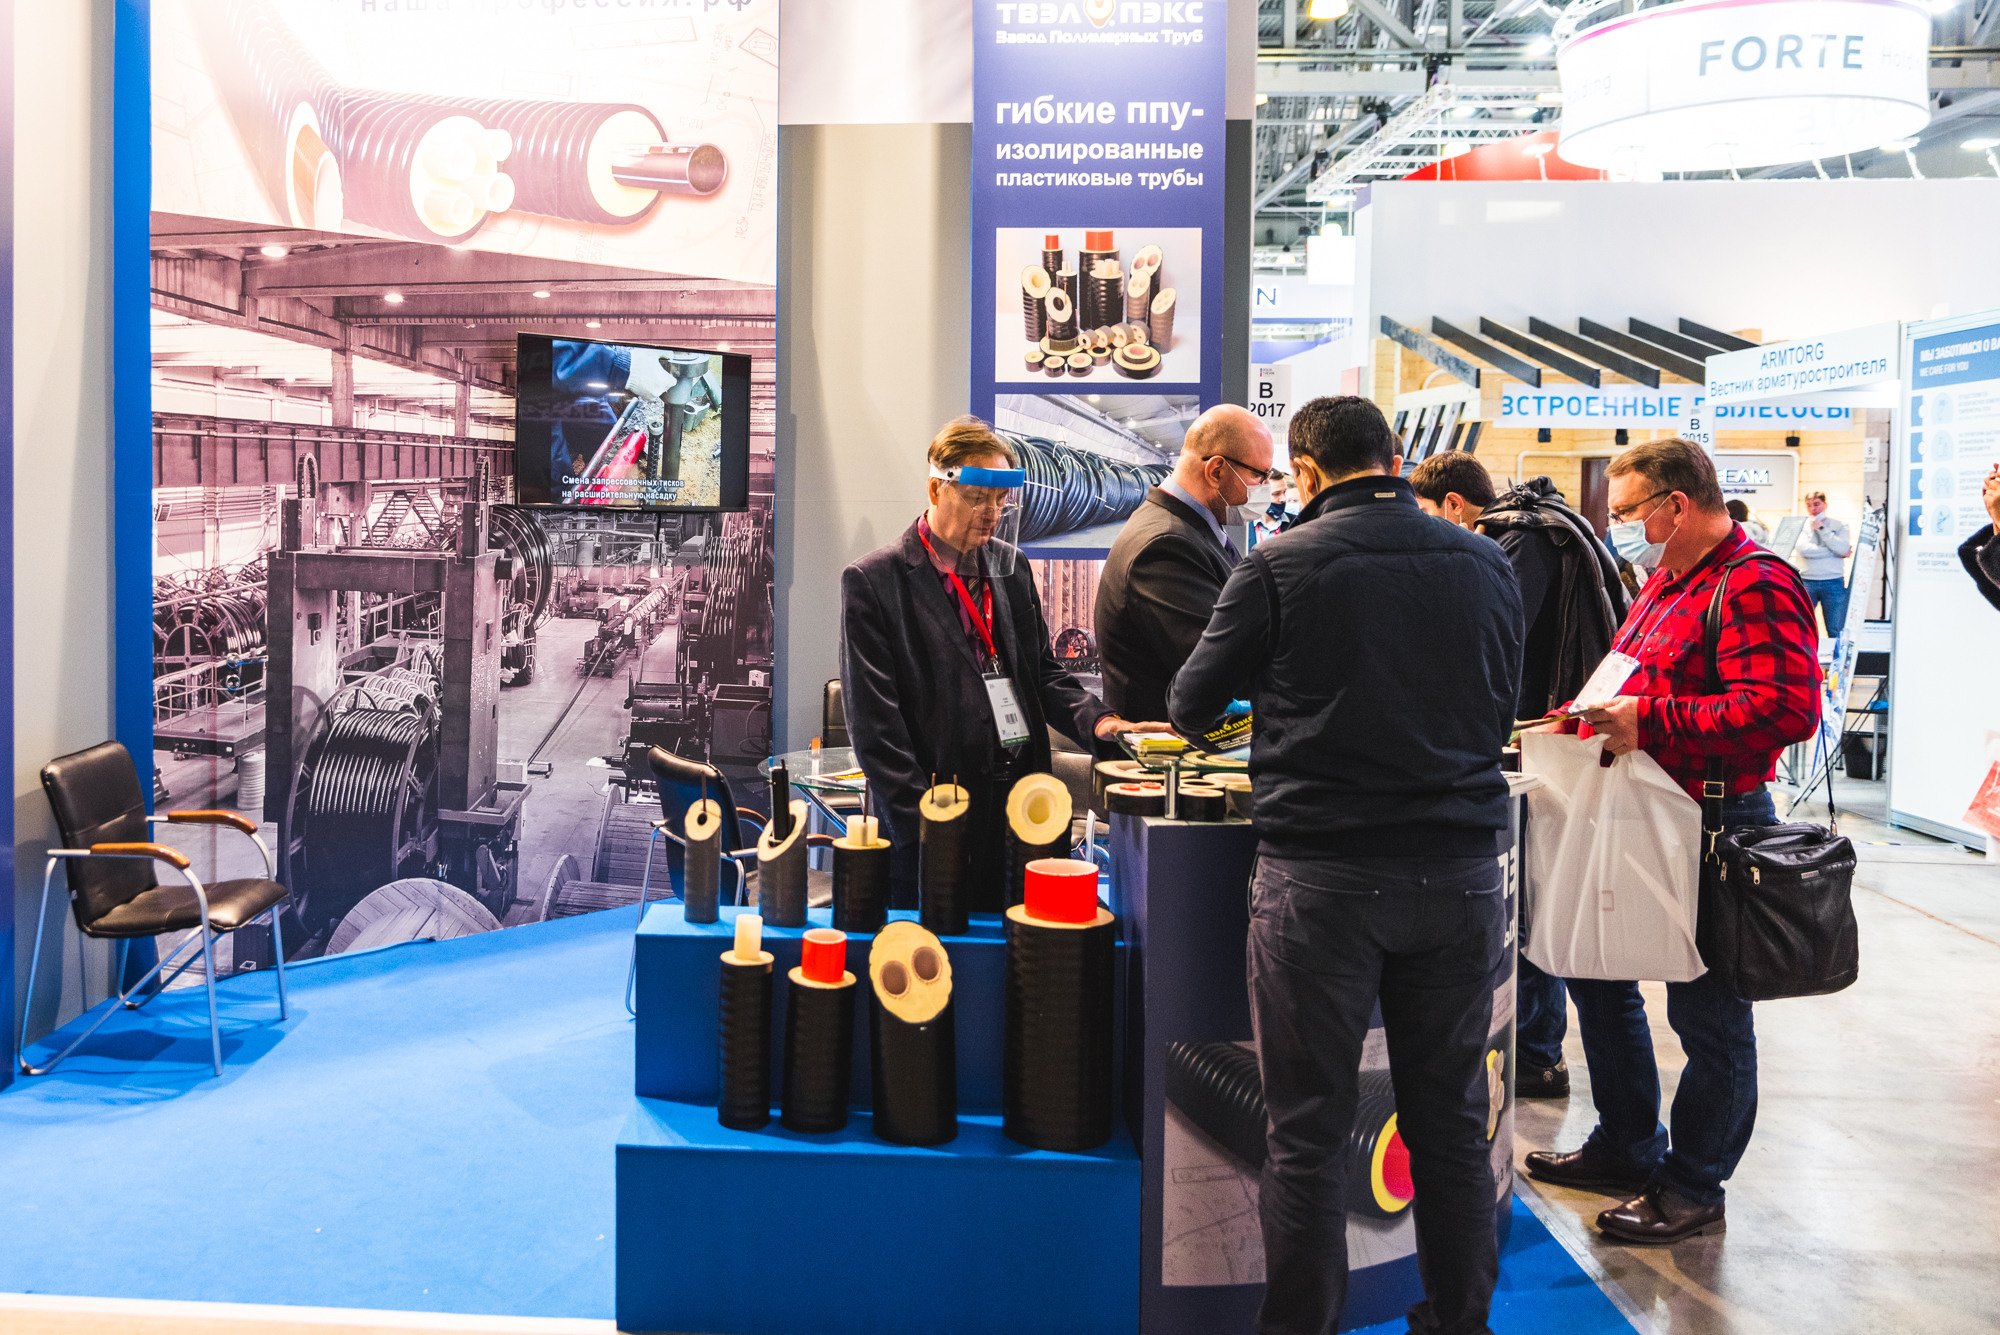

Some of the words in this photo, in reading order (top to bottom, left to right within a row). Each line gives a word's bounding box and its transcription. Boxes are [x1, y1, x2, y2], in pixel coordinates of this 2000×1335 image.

[996, 3, 1082, 25] ТВЭЛ
[1119, 2, 1204, 24] ПЭКС
[1161, 29, 1204, 46] Труб
[1698, 34, 1865, 77] FORTE
[996, 94, 1116, 124] гибкие
[1127, 101, 1205, 131] ппу-
[996, 142, 1204, 165] изолированные
[996, 172, 1133, 187] пластиковые
[1137, 168, 1204, 190] трубы
[1760, 342, 1825, 371] ARMTORG
[1934, 339, 1983, 360] ЗАБОТИМСЯ
[1710, 376, 1755, 398] Вестник
[1756, 357, 1888, 391] арматуростроителя
[1502, 395, 1682, 417] ВСТРОЕННЫЕ
[562, 475, 590, 486] Смена
[591, 477, 658, 488] запрессовочных
[659, 478, 685, 488] тисков
[562, 490, 572, 498] на
[574, 490, 645, 500] расширительную
[646, 491, 677, 502] насадку
